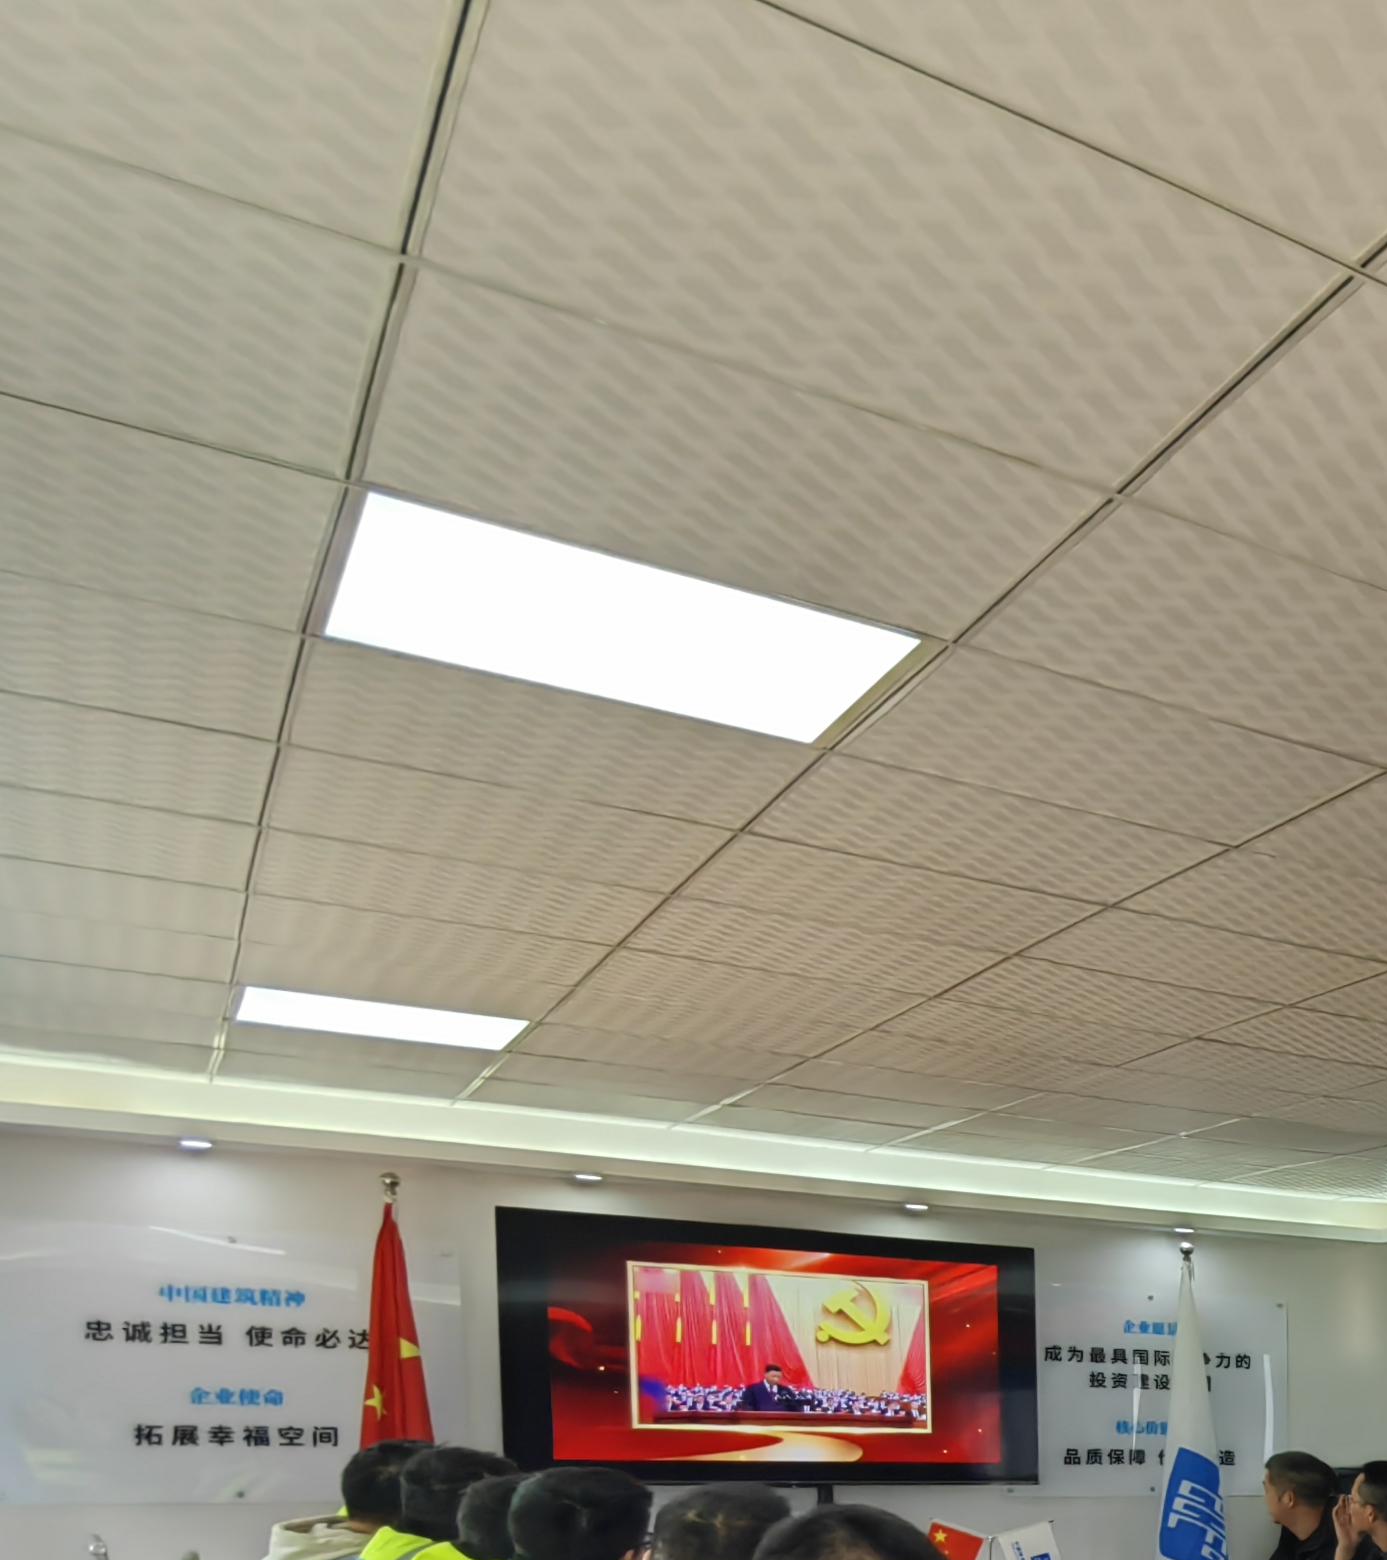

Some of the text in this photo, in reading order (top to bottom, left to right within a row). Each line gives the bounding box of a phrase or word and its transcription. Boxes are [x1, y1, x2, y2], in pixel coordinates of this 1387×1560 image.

[158, 1284, 307, 1308] 中国建筑精神
[84, 1319, 369, 1352] 忠诚担当 使命必达
[1043, 1344, 1252, 1371] 成为最具国际力的
[189, 1386, 285, 1408] 企业使命
[133, 1423, 339, 1448] 拓展幸福空间
[1063, 1448, 1146, 1466] 品质保障
